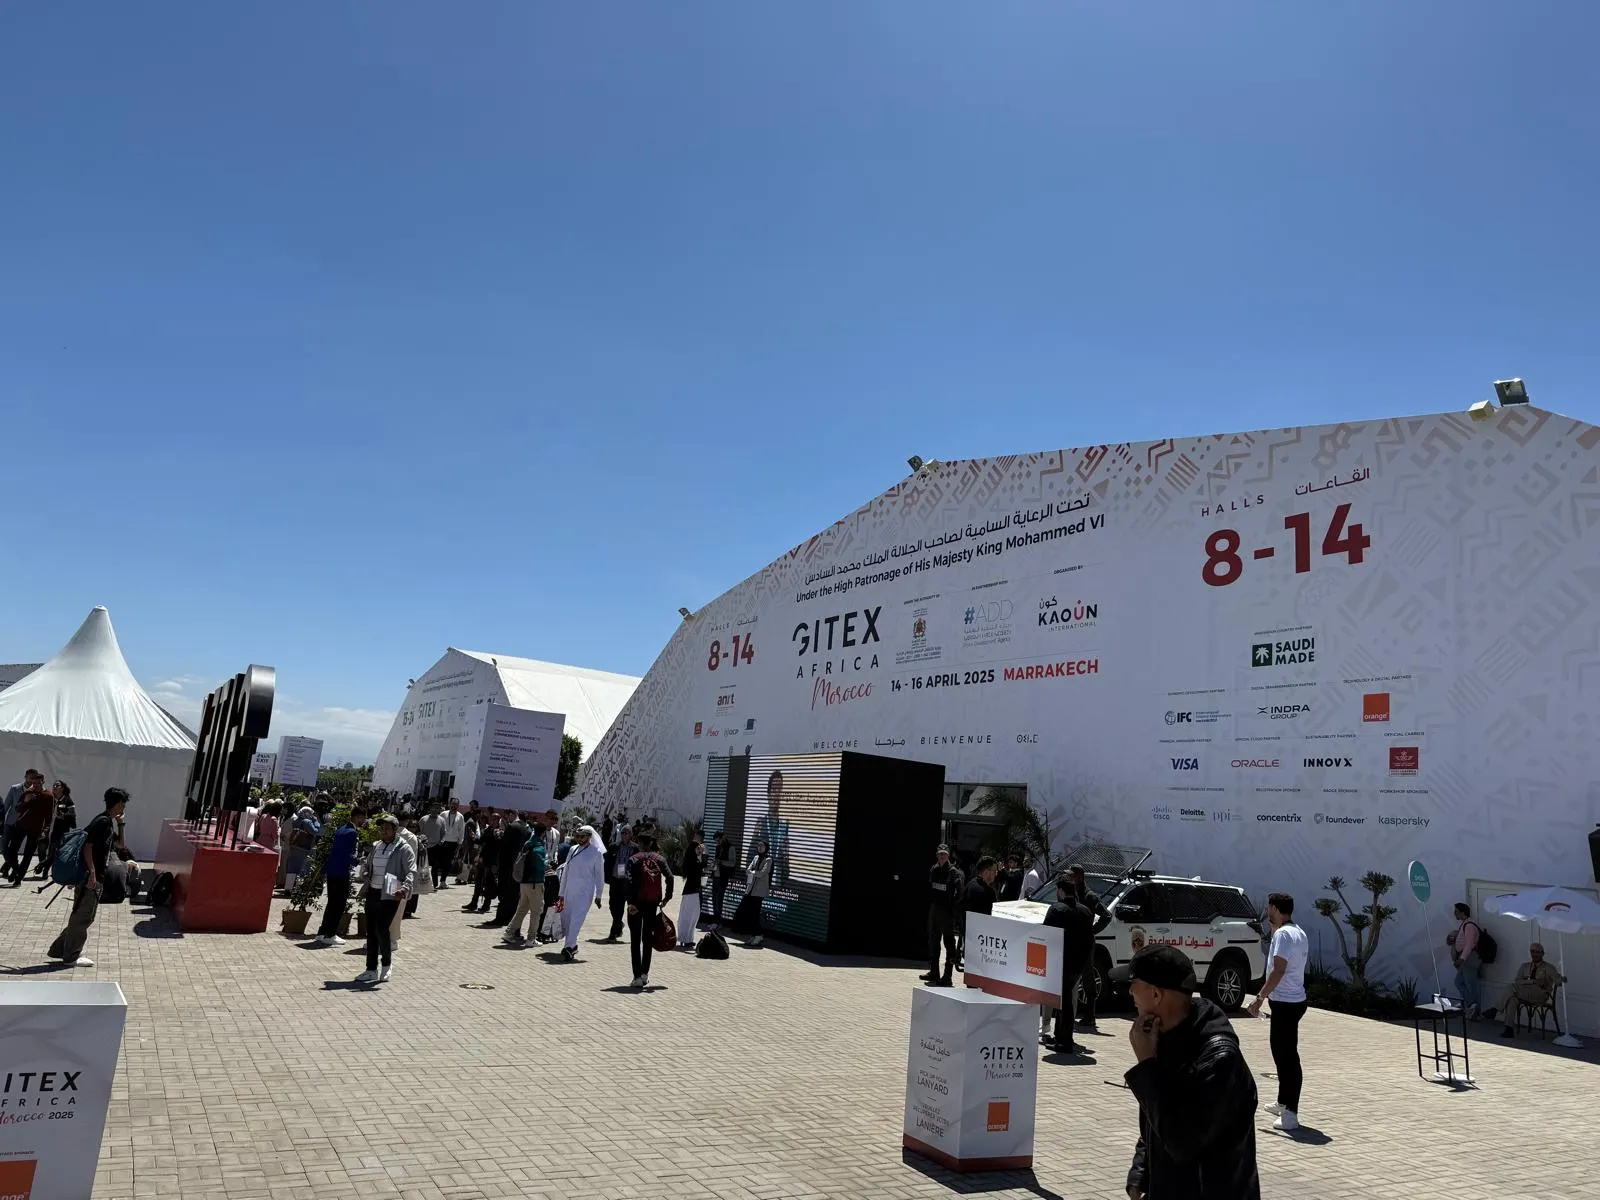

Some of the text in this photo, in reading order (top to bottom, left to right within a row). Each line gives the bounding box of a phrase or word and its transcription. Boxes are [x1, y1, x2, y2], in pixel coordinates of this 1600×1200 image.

[1295, 467, 1370, 496] القاعات
[1201, 494, 1265, 517] HALLS
[805, 493, 1090, 585] تحت الرعاية السامية لصاحب الجلالة الملك محمد السادس
[796, 514, 1105, 603] Under the High Patronage of His Majesty King Mohammed VI
[792, 605, 882, 657] GITEX
[1048, 621, 1097, 633] INTERNATIONAL
[707, 632, 755, 672] 8-14
[1275, 637, 1315, 653] SAUDI
[797, 653, 880, 679] AFRICA
[1275, 651, 1315, 666] MADE
[1003, 659, 1099, 681] MARRAKECH
[891, 680, 902, 692] 14
[911, 677, 923, 690] 16
[926, 672, 960, 689] APRIL
[964, 669, 995, 686] 2025
[811, 676, 875, 711] Morocco
[1176, 711, 1193, 723] IFC
[1271, 704, 1311, 715] INDRA
[1271, 713, 1298, 721] GROUP
[1363, 712, 1388, 721] orange
[812, 739, 859, 750] WELCOME
[921, 734, 992, 745] BIENVENUE
[1170, 758, 1199, 770] VISA
[1231, 759, 1280, 768] ORACLE
[1256, 813, 1302, 823] concentrix
[1325, 815, 1366, 825] foundever
[1378, 815, 1430, 828] kaspersky
[977, 934, 1008, 951] GITEX
[980, 1046, 1025, 1061] GITEX
[3, 1071, 82, 1093] ITEX
[917, 1075, 949, 1096] LANYARD
[1, 1096, 76, 1108] FRICA
[48, 1110, 75, 1121] 2025
